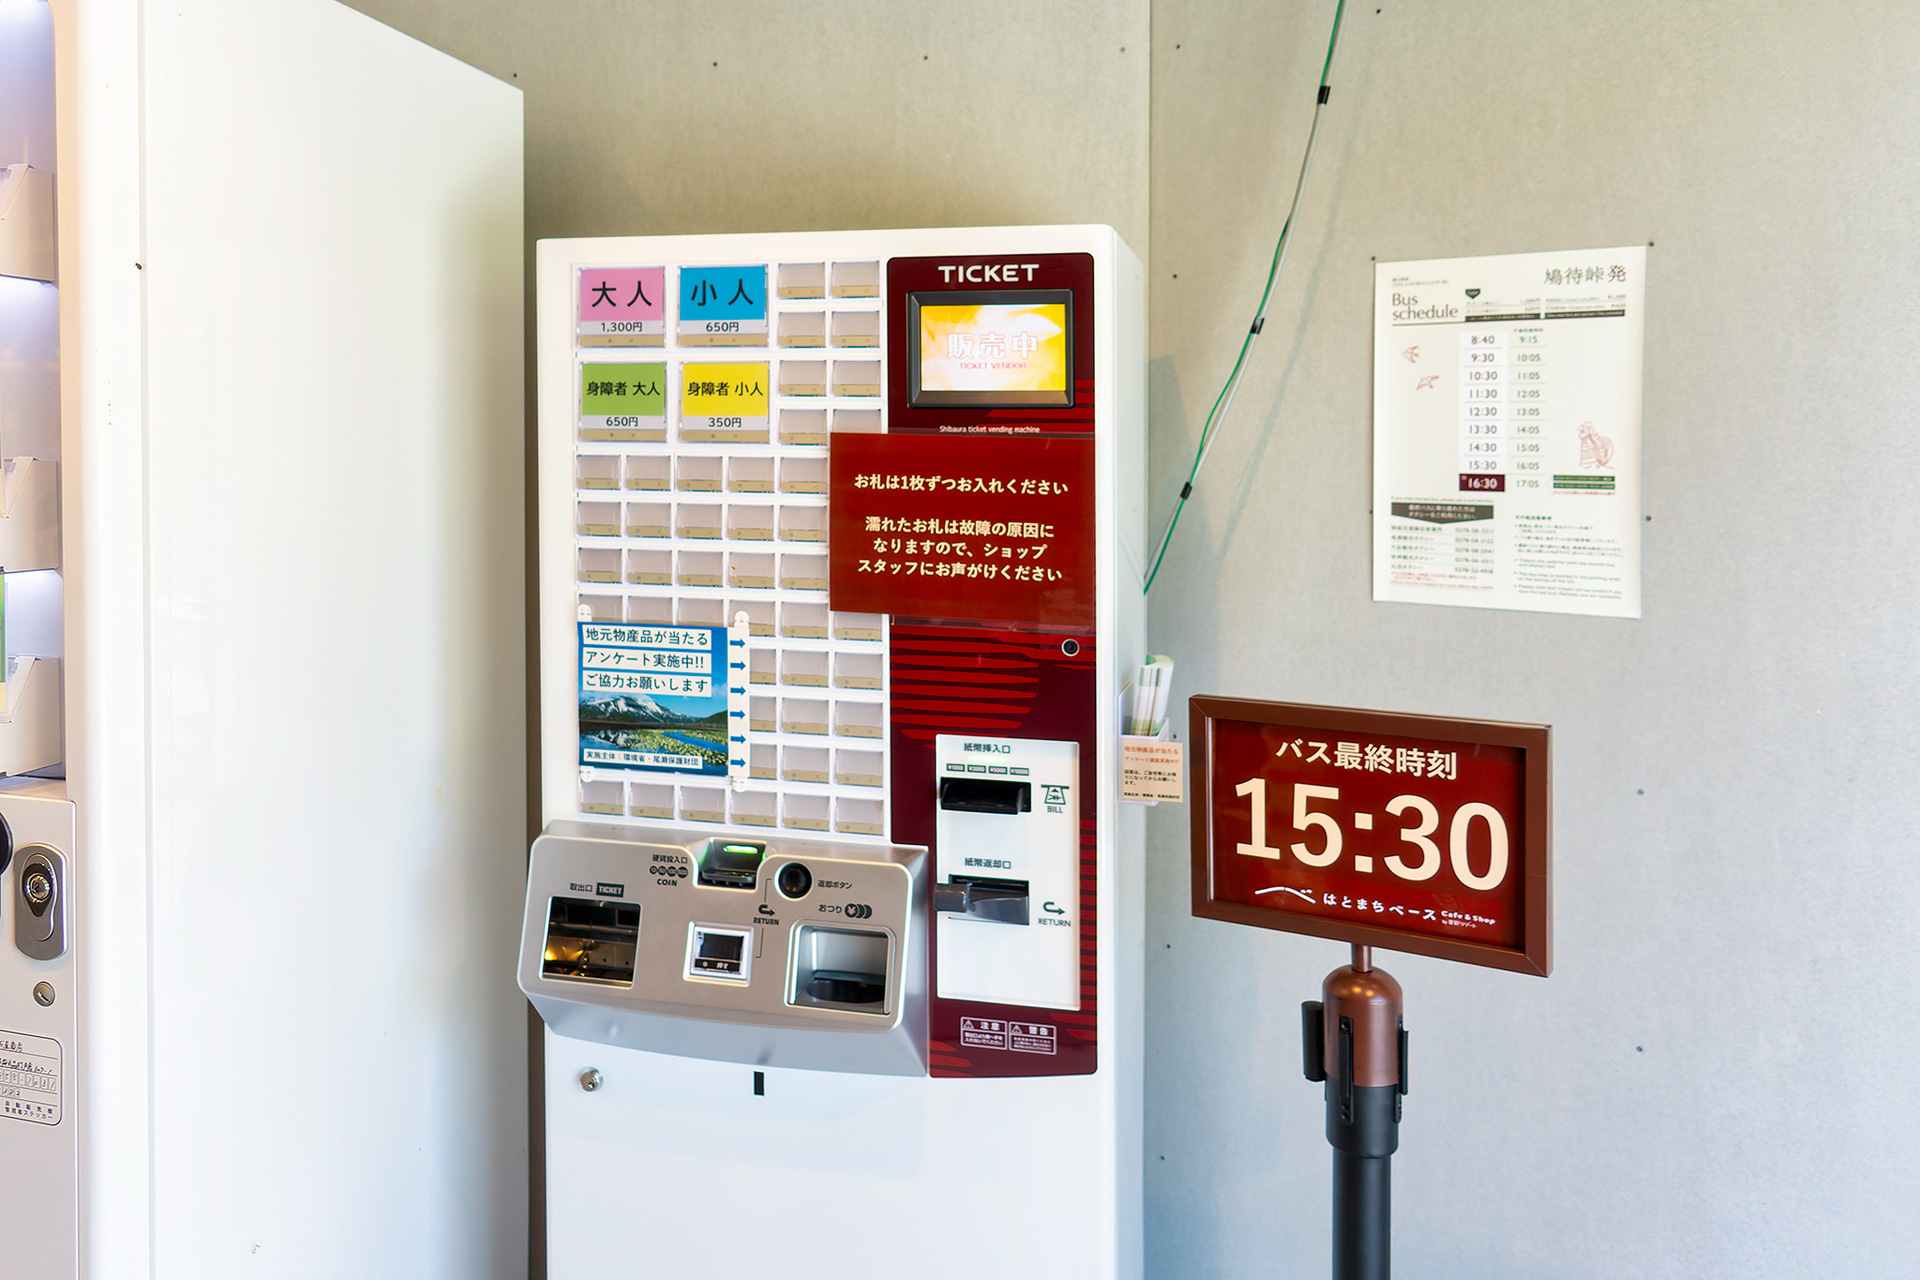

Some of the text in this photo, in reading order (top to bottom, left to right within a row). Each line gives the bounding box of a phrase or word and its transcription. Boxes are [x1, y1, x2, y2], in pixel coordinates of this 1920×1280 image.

[938, 263, 1040, 284] TICKET
[1544, 264, 1627, 286] 鳩待峠発
[592, 280, 652, 308] 大人
[691, 279, 754, 306] 小人
[1392, 293, 1418, 307] Bus
[1392, 304, 1458, 320] schedule
[600, 322, 643, 332] 1,300円
[706, 322, 740, 332] 650円
[1471, 335, 1495, 344] 8:40
[1519, 335, 1538, 344] 9:15
[946, 331, 1038, 360] 販売中
[1471, 353, 1495, 362] 9:30
[1517, 353, 1541, 362] 10:05
[960, 362, 1027, 370] TICKET VENDOR
[1469, 371, 1498, 380] 10:30
[1517, 371, 1540, 380] 11:05
[586, 382, 661, 396] 身障者 大人
[688, 382, 764, 396] 身障者 小人
[1469, 389, 1497, 398] 11:30
[1517, 389, 1540, 398] 12:05
[1469, 407, 1497, 416] 12:30
[1517, 407, 1540, 416] 13:05
[606, 416, 638, 427] 650円
[708, 418, 742, 428] 350円
[939, 425, 967, 433] Shibaura
[988, 426, 1013, 435] vending
[1014, 426, 1040, 434] machine
[1469, 425, 1497, 434] 13:30
[1516, 425, 1540, 434] 14:05
[1469, 443, 1497, 452] 14:30
[1516, 443, 1540, 452] 15:05
[1469, 461, 1497, 470] 15:30
[1516, 461, 1540, 470] 16:05
[854, 474, 1069, 495] お札は1枚ずつお入れください
[1467, 478, 1498, 488] 16:30
[1516, 478, 1540, 488] 17:05
[865, 516, 1054, 539] 濡れたお札は故障の原因に
[873, 538, 1048, 560] なりますので、ショップ
[858, 558, 1062, 582] スタッフにお声がけください
[586, 628, 708, 646] 地元物産品が当たる
[586, 651, 704, 669] アンケート実施中!!
[586, 674, 708, 692] ご協力お願いします
[964, 742, 1010, 754] 紙幣挿入口
[1276, 738, 1458, 780] バス最終時刻
[1046, 806, 1064, 814] BILL
[1235, 777, 1510, 892] 15:30
[964, 858, 1011, 870] 紙幣返却口
[570, 882, 592, 893] 取出口
[656, 878, 678, 887] COIN
[817, 880, 853, 890] 返却ボタン
[598, 884, 623, 896] TICKET
[818, 904, 843, 914] おつり
[1323, 892, 1436, 922] はとまちベース
[753, 917, 779, 926] RETURN
[1038, 918, 1071, 927] RETURN
[1440, 910, 1463, 919] Cafe
[1472, 915, 1496, 925] Shop
